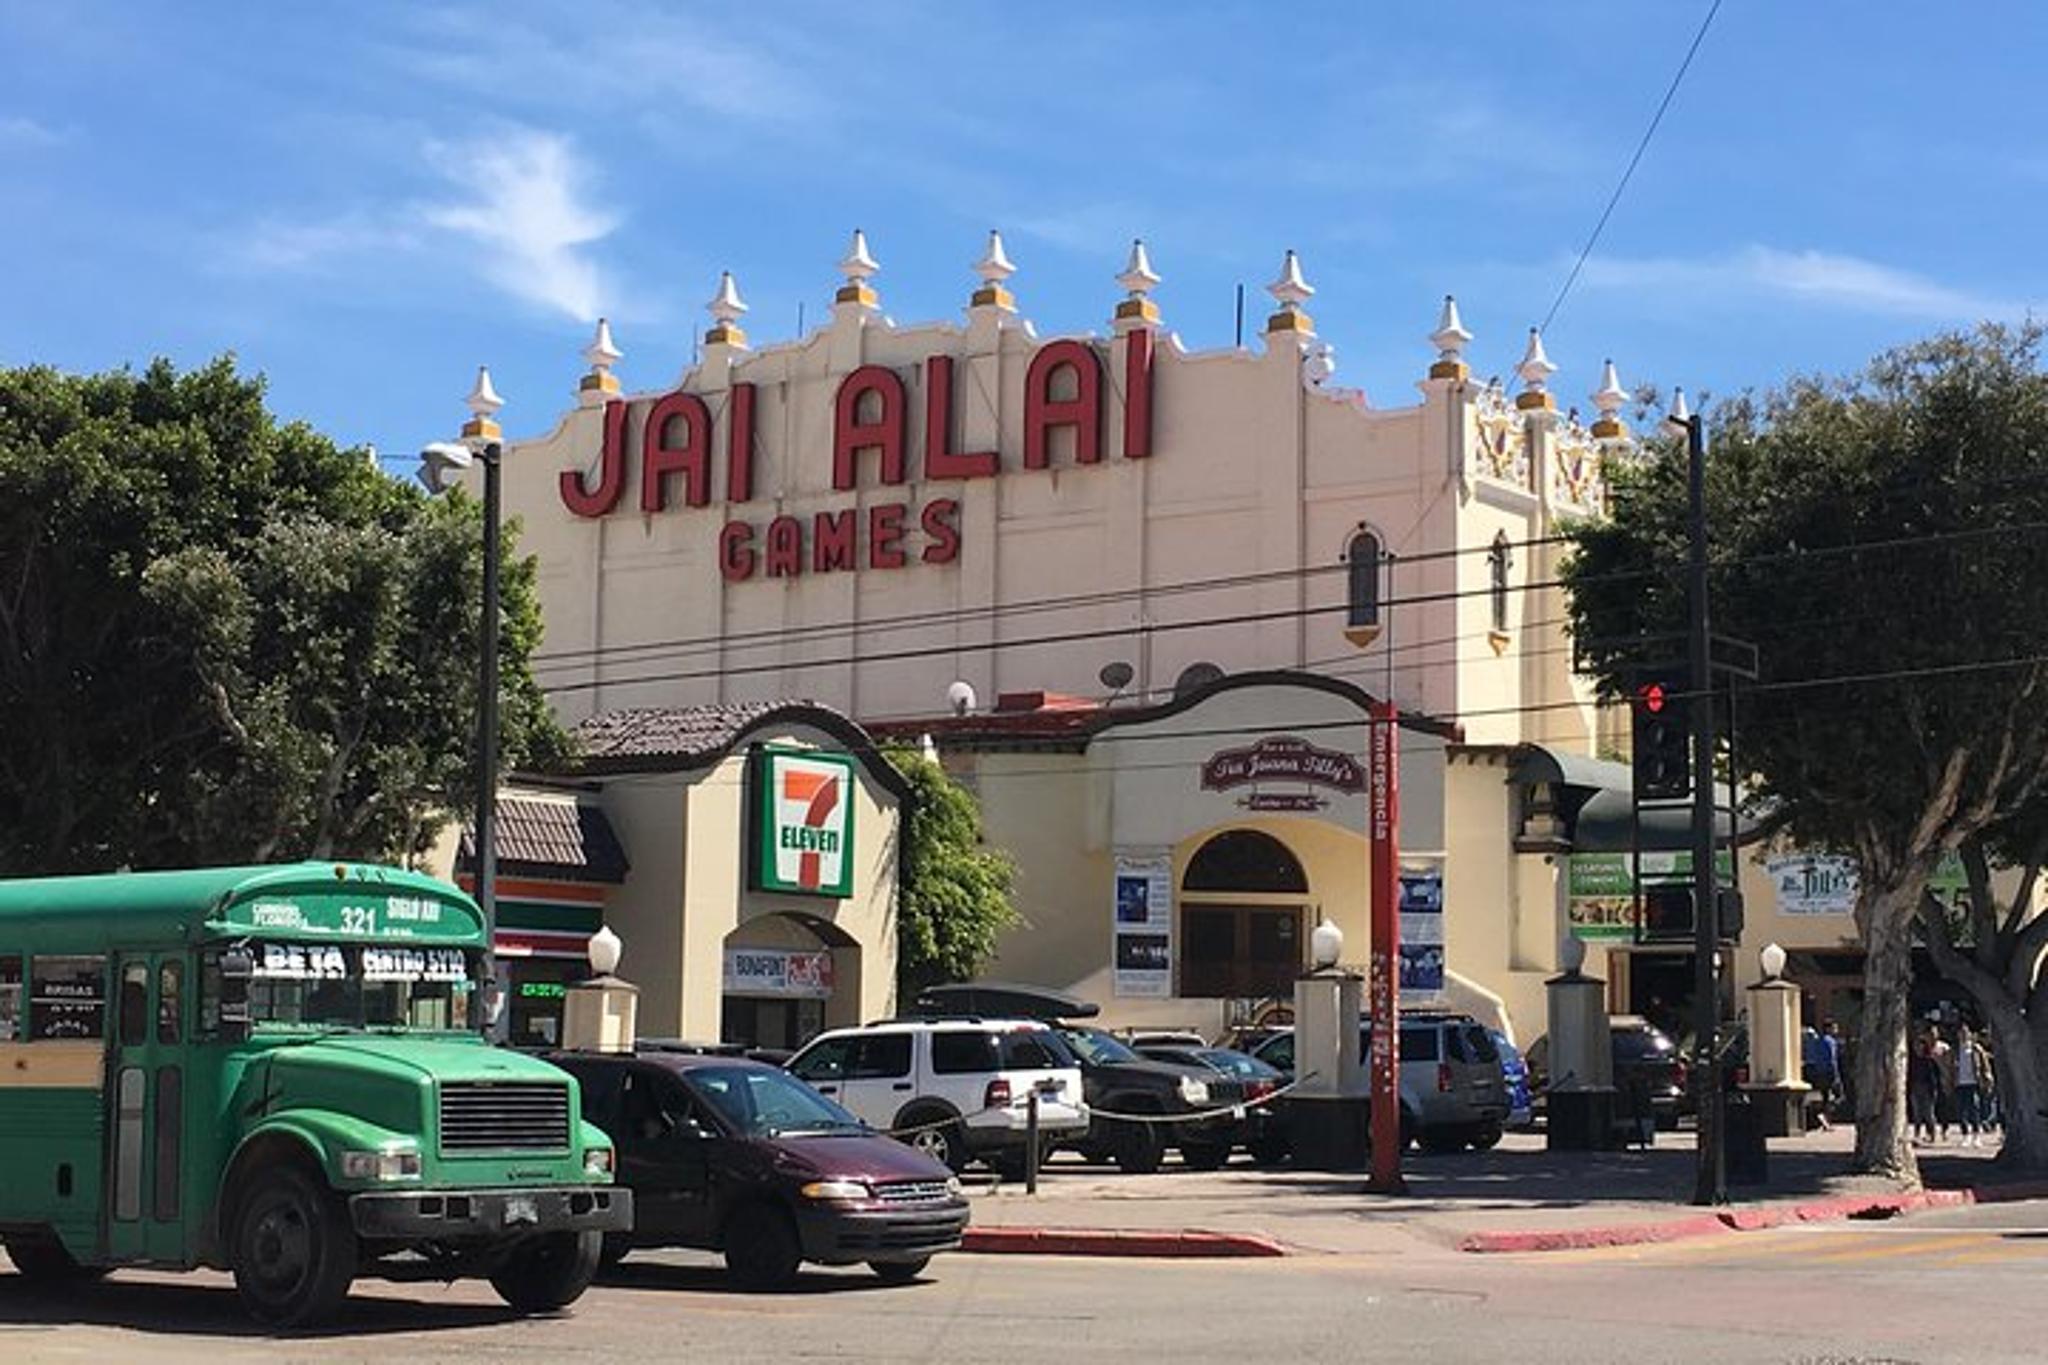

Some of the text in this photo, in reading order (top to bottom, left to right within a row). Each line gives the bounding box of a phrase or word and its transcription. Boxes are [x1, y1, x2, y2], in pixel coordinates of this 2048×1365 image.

[560, 329, 1154, 518] JAI ALAI
[719, 498, 961, 582] GAMES
[784, 771, 839, 888] 7
[340, 907, 376, 935] 321
